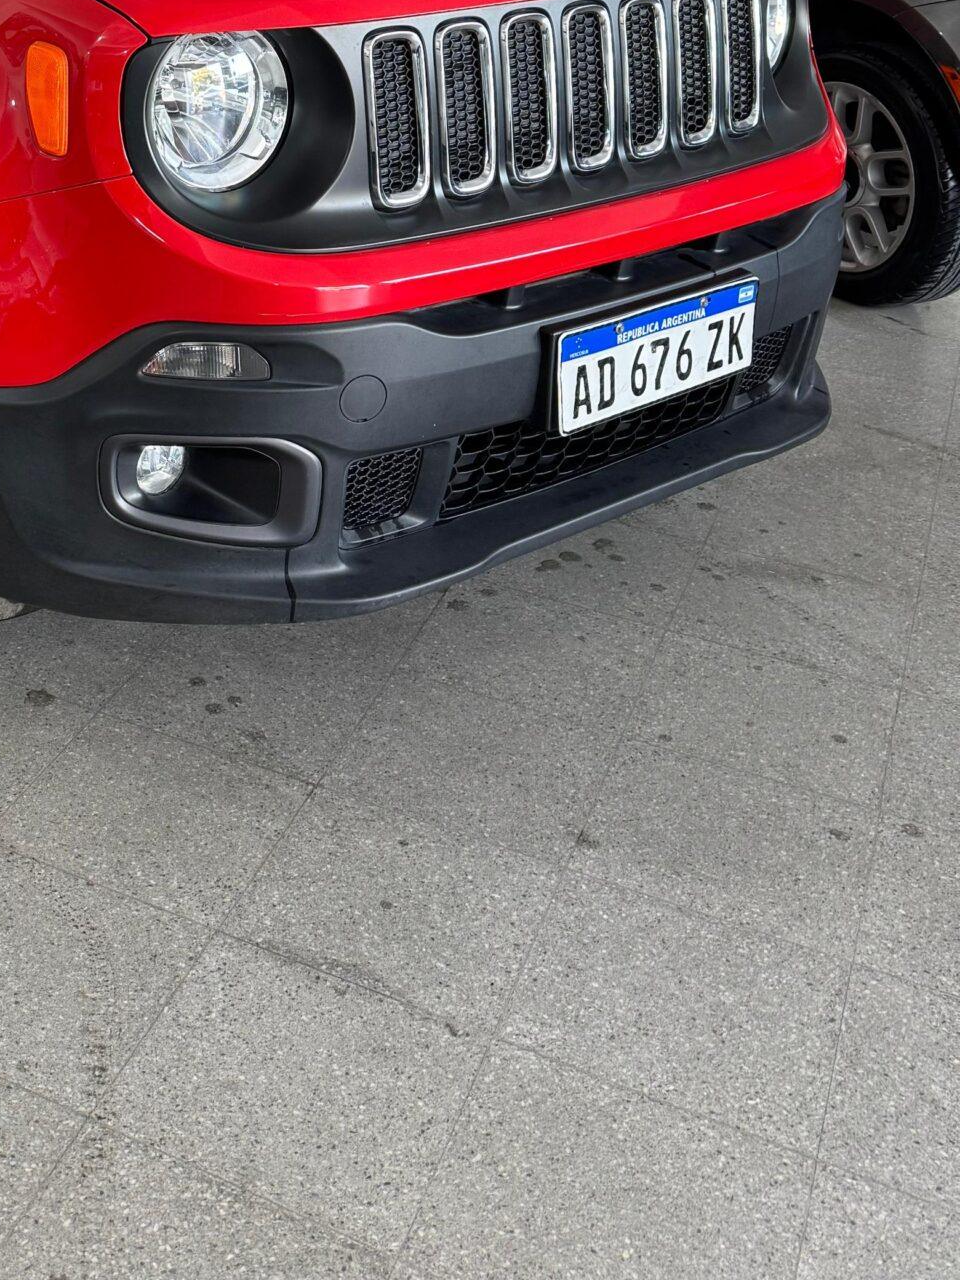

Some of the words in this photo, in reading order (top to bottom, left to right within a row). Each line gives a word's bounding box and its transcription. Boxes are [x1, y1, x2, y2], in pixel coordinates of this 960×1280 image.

[617, 321, 659, 344] REPUBLICA
[661, 307, 706, 330] ARGENTINA
[573, 355, 616, 420] AD
[630, 330, 693, 397] 676
[706, 312, 746, 373] ZK
